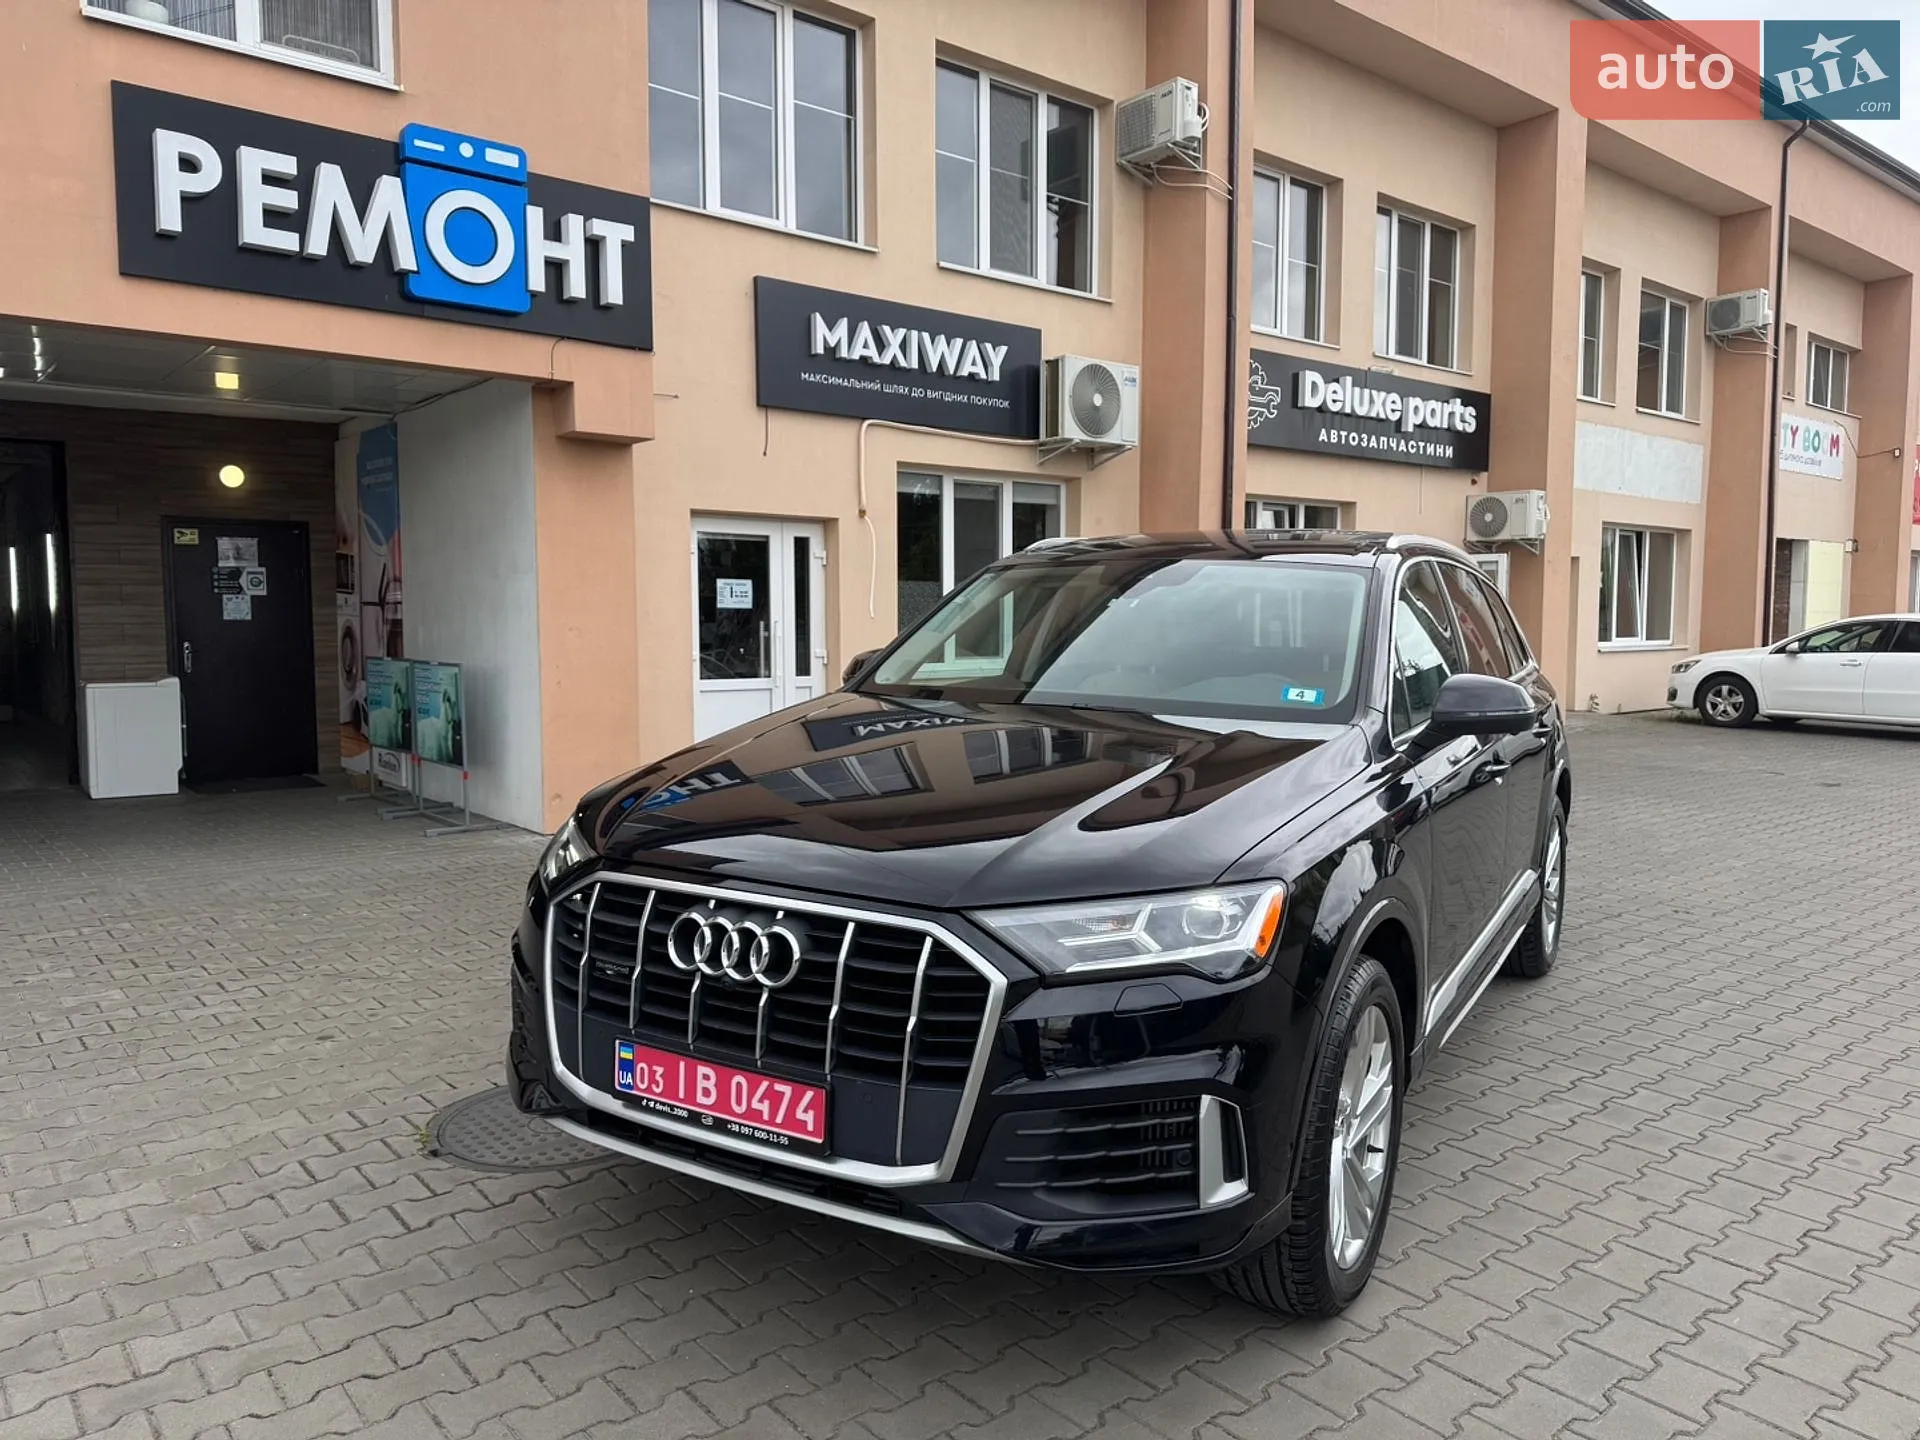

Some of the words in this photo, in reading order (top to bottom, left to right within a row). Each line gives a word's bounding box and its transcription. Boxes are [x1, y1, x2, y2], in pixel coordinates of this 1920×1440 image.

[152, 127, 635, 308] РЕМОНТ
[811, 312, 1008, 382] MAXIWAY
[800, 372, 881, 391] МАКСИМАЛЬНИЙ
[883, 383, 909, 396] ШЛЯХ
[911, 387, 926, 399] ДО
[927, 389, 969, 404] ВИГІДНИХ
[970, 395, 1011, 409] ПОКУПОК
[1298, 369, 1402, 422] Deluxe
[1401, 396, 1477, 433] parts
[1319, 428, 1454, 459] АВТОЗАПЧАСТИНИ
[1295, 690, 1305, 699] 4
[619, 1069, 634, 1086] UA
[636, 1062, 665, 1094] 03
[679, 1060, 717, 1106] IB
[730, 1074, 815, 1132] 0474
